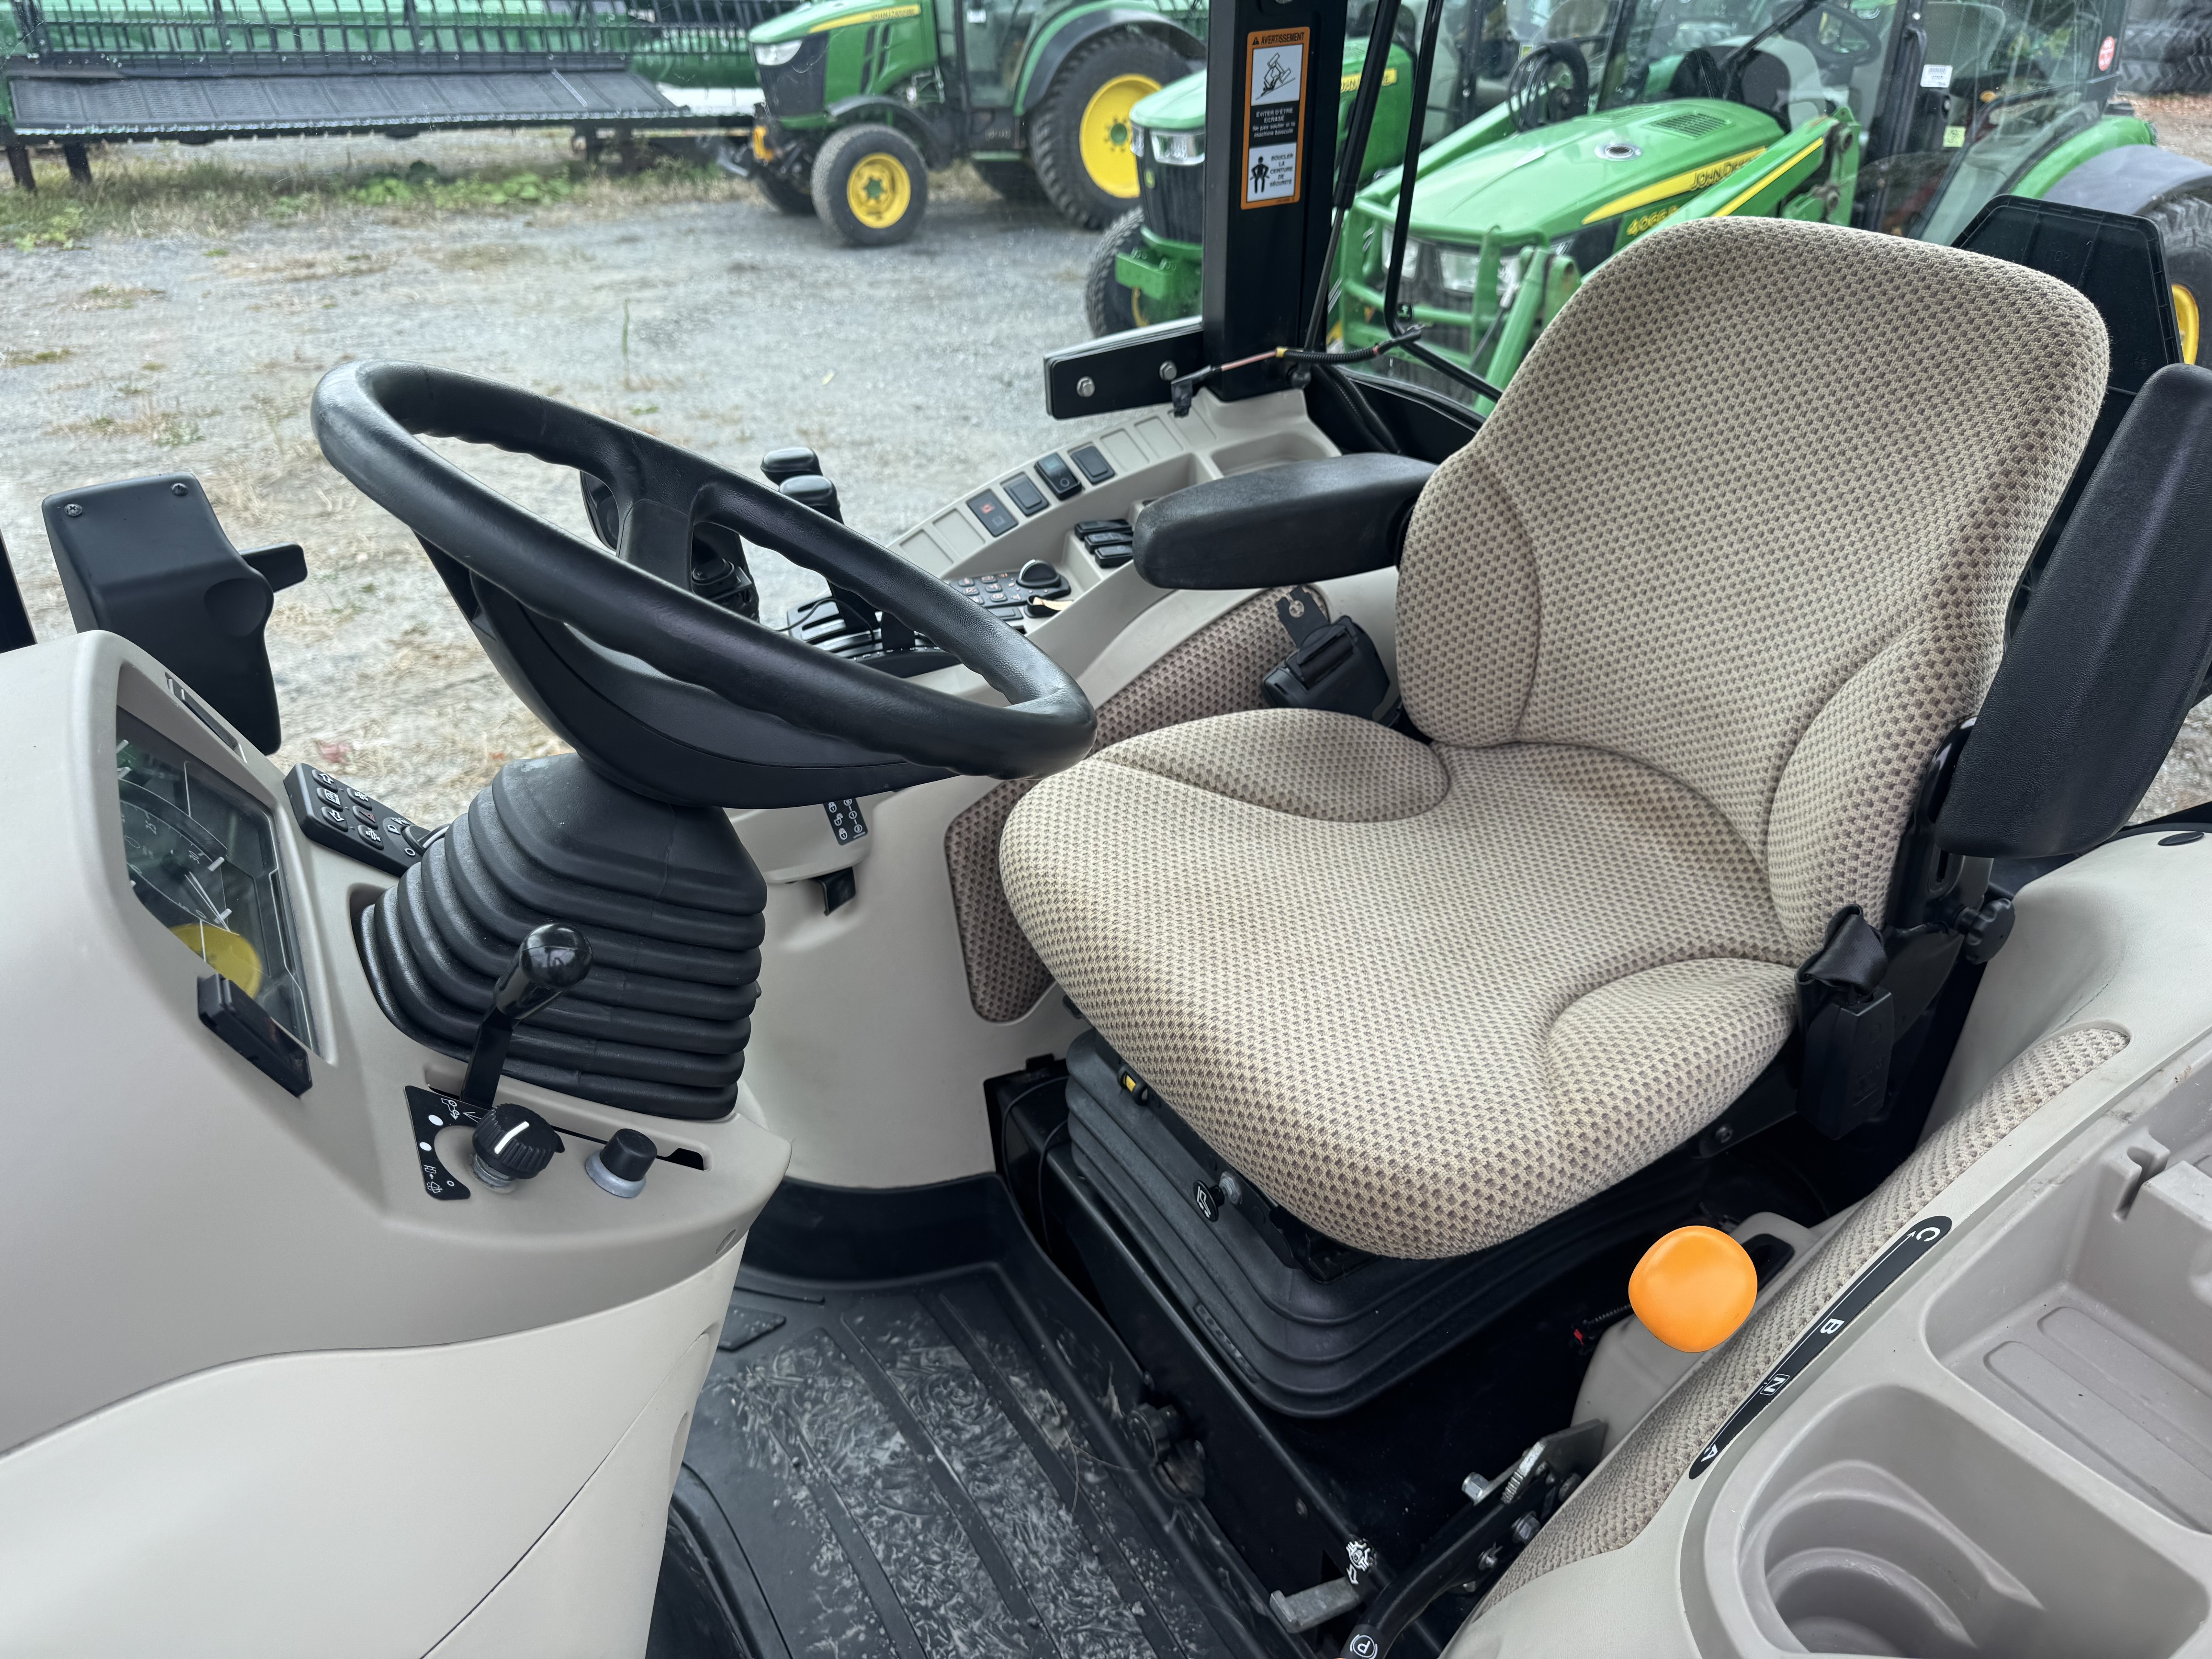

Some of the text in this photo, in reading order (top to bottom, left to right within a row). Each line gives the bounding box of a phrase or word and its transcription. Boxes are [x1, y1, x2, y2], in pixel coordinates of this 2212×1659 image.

[1261, 33, 1304, 45] AVERTISSEMENT
[1916, 1227, 1940, 1242] C
[1820, 1318, 1844, 1334] B
[1764, 1377, 1786, 1393] N
[1701, 1444, 1718, 1462] A
